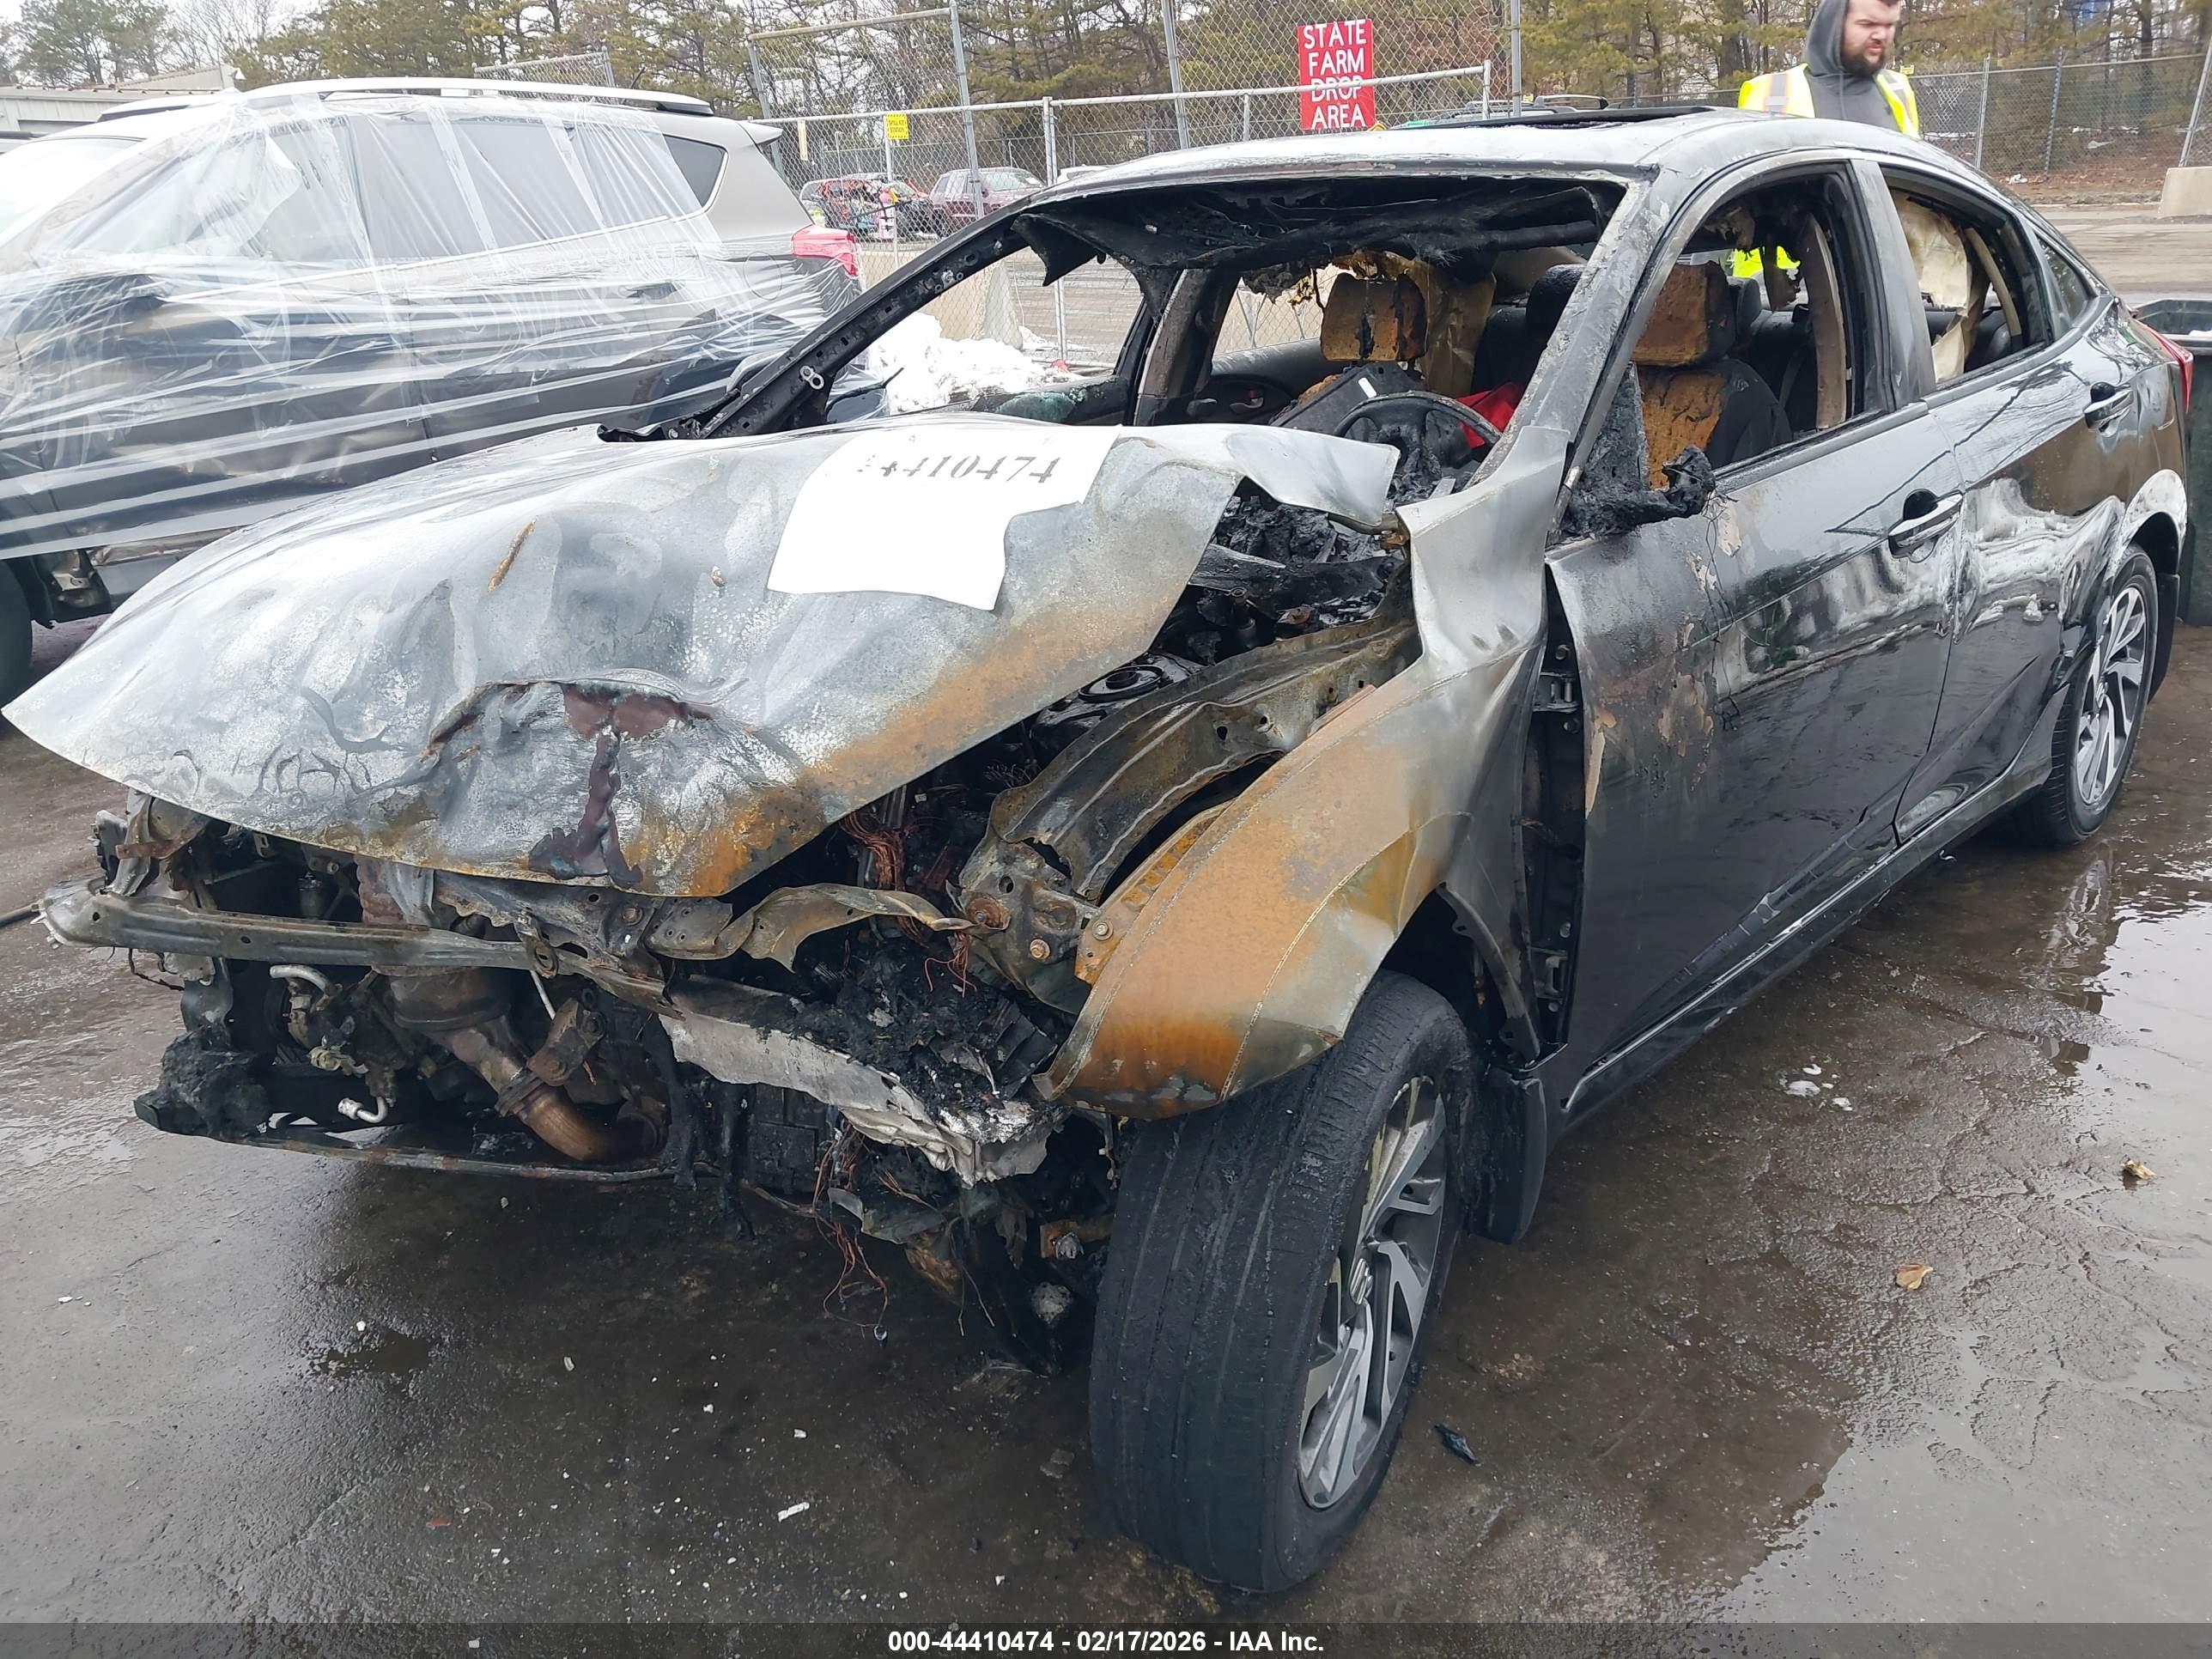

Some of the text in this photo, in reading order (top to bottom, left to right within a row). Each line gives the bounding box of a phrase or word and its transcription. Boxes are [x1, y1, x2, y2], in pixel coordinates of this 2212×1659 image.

[1303, 20, 1366, 49] STATE
[1308, 47, 1364, 76] FARM
[1310, 76, 1364, 101] DROP
[1311, 104, 1366, 130] AREA
